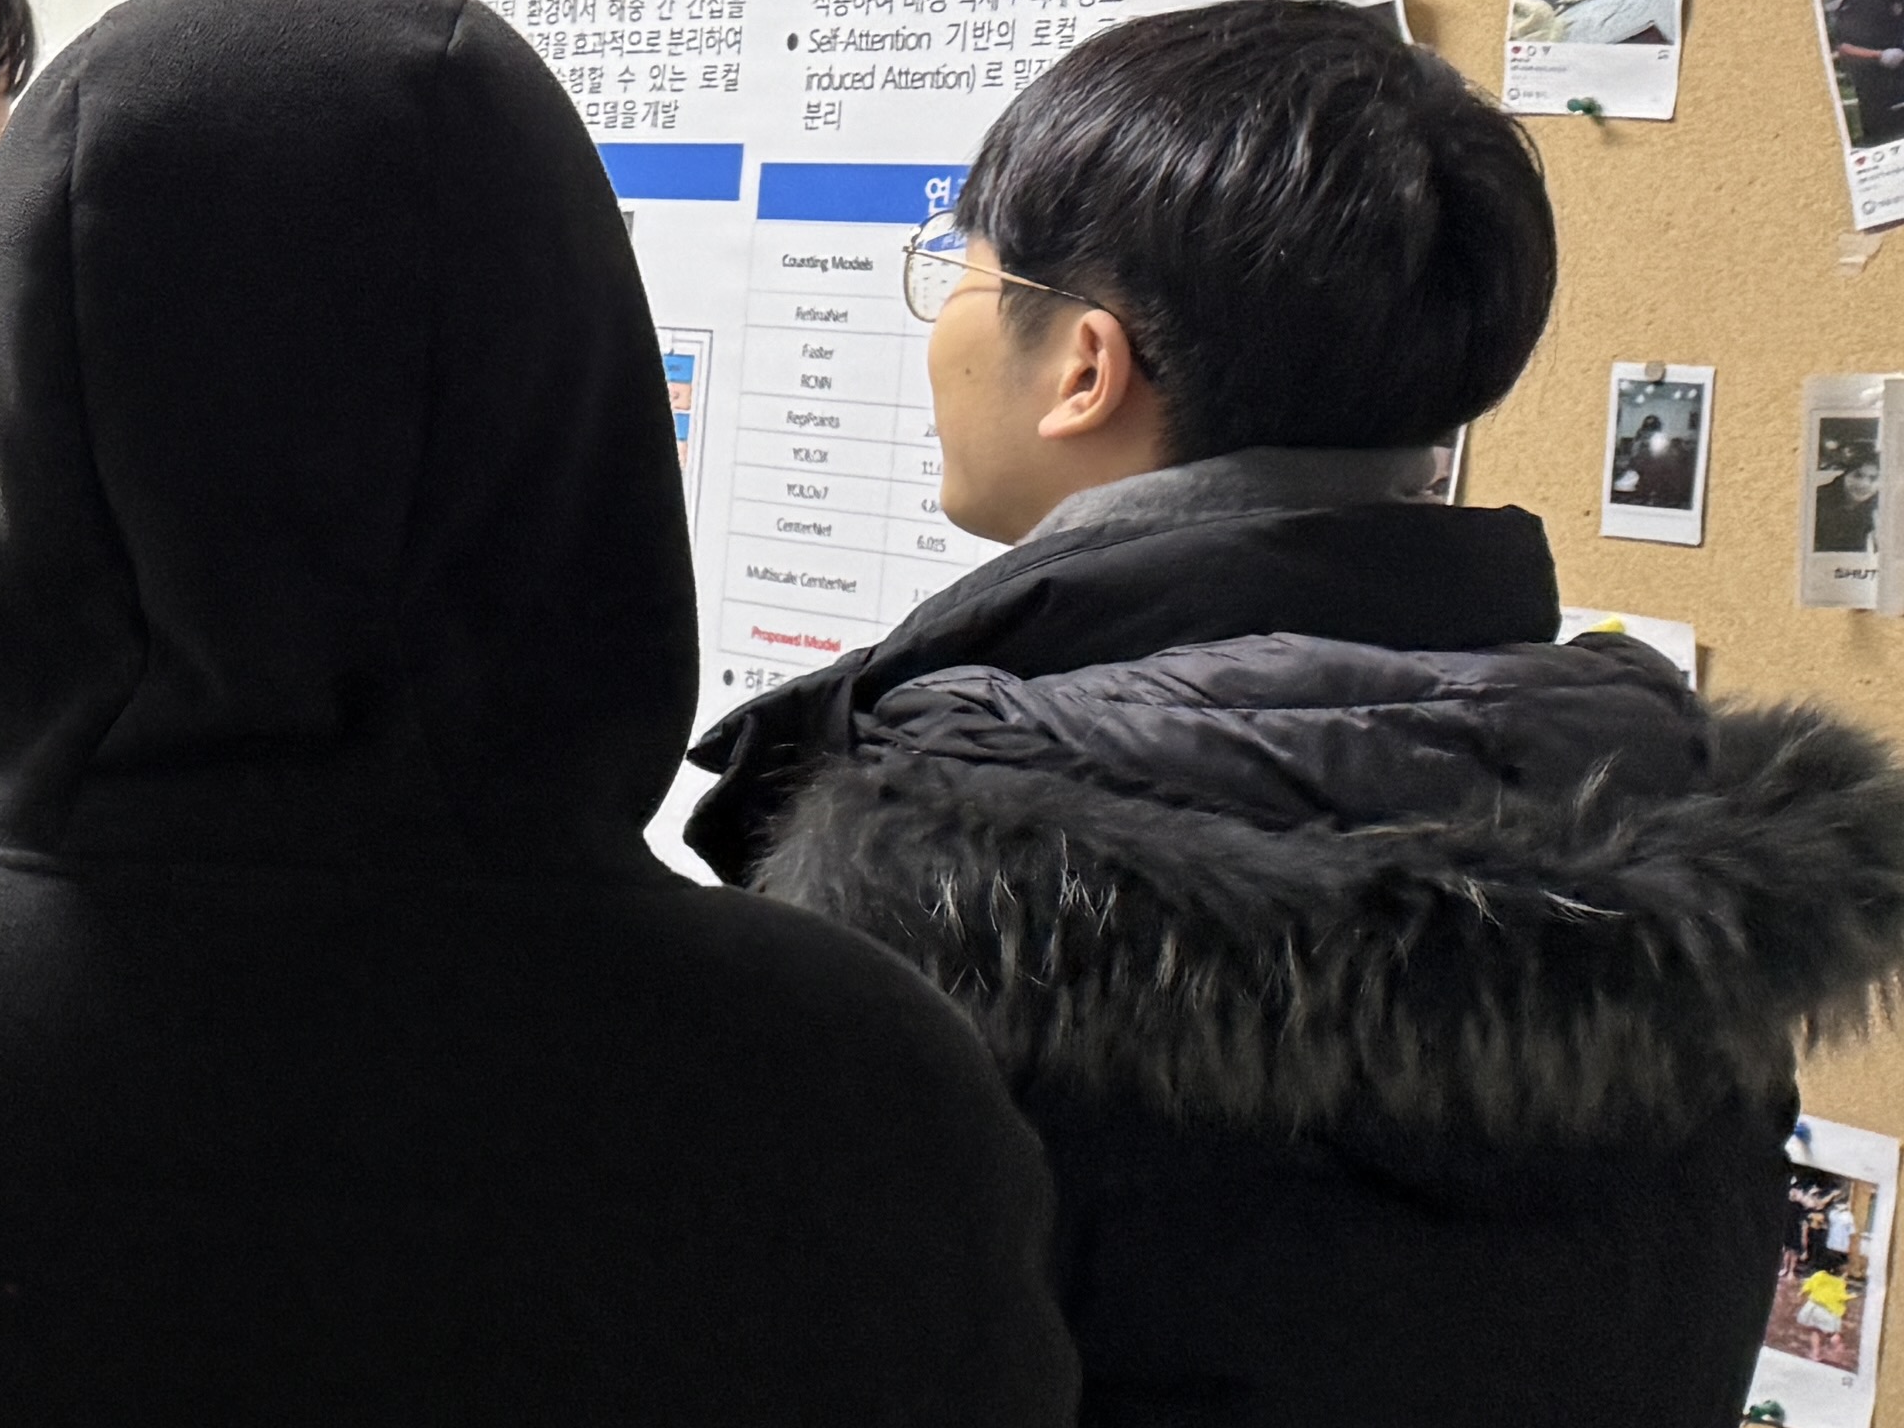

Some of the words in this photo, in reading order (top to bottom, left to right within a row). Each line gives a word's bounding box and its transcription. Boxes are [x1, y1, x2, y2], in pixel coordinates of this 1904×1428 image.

[572, 28, 662, 59] 효과적으로
[667, 25, 743, 57] 분리하여
[808, 24, 932, 53] Self-Attention
[945, 18, 1017, 52] 기반의
[1030, 16, 1077, 50] 로컬
[617, 64, 636, 93] 수
[648, 63, 687, 92] 있는
[698, 62, 740, 92] 로컬
[805, 64, 874, 92] induced
[881, 63, 976, 93] Attention)
[982, 61, 1004, 88] 로
[586, 99, 638, 129] 모델을
[641, 99, 680, 129] 개발
[803, 100, 842, 131] 분리
[782, 254, 829, 272] Counting
[831, 255, 874, 271] Models
[802, 343, 834, 360] Faster
